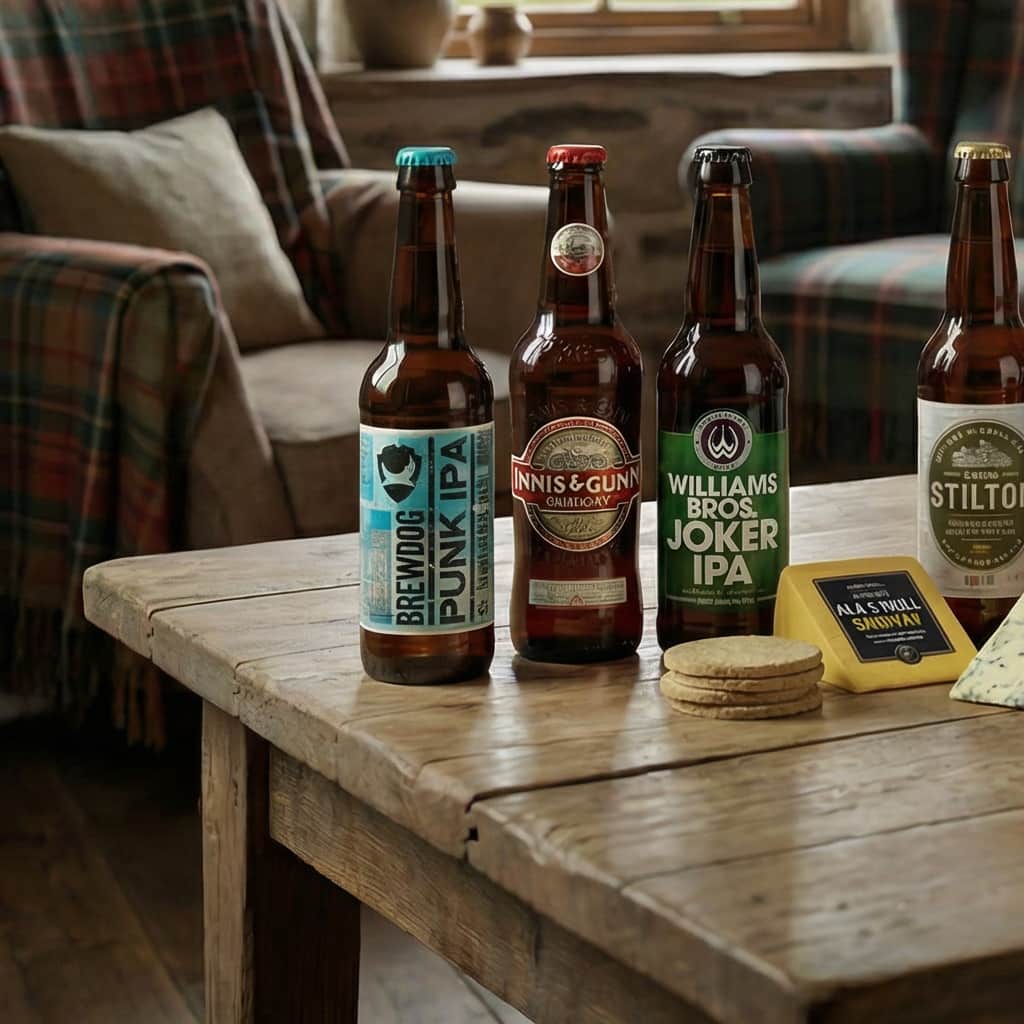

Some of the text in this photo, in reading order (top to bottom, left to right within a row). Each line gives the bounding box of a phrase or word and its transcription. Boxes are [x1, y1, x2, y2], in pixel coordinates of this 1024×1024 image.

[668, 472, 778, 497] WILLIAMS
[439, 435, 468, 626] PUNK IPA
[666, 518, 779, 553] JOKER
[396, 510, 425, 626] BREWDOG
[693, 554, 753, 586] IPA
